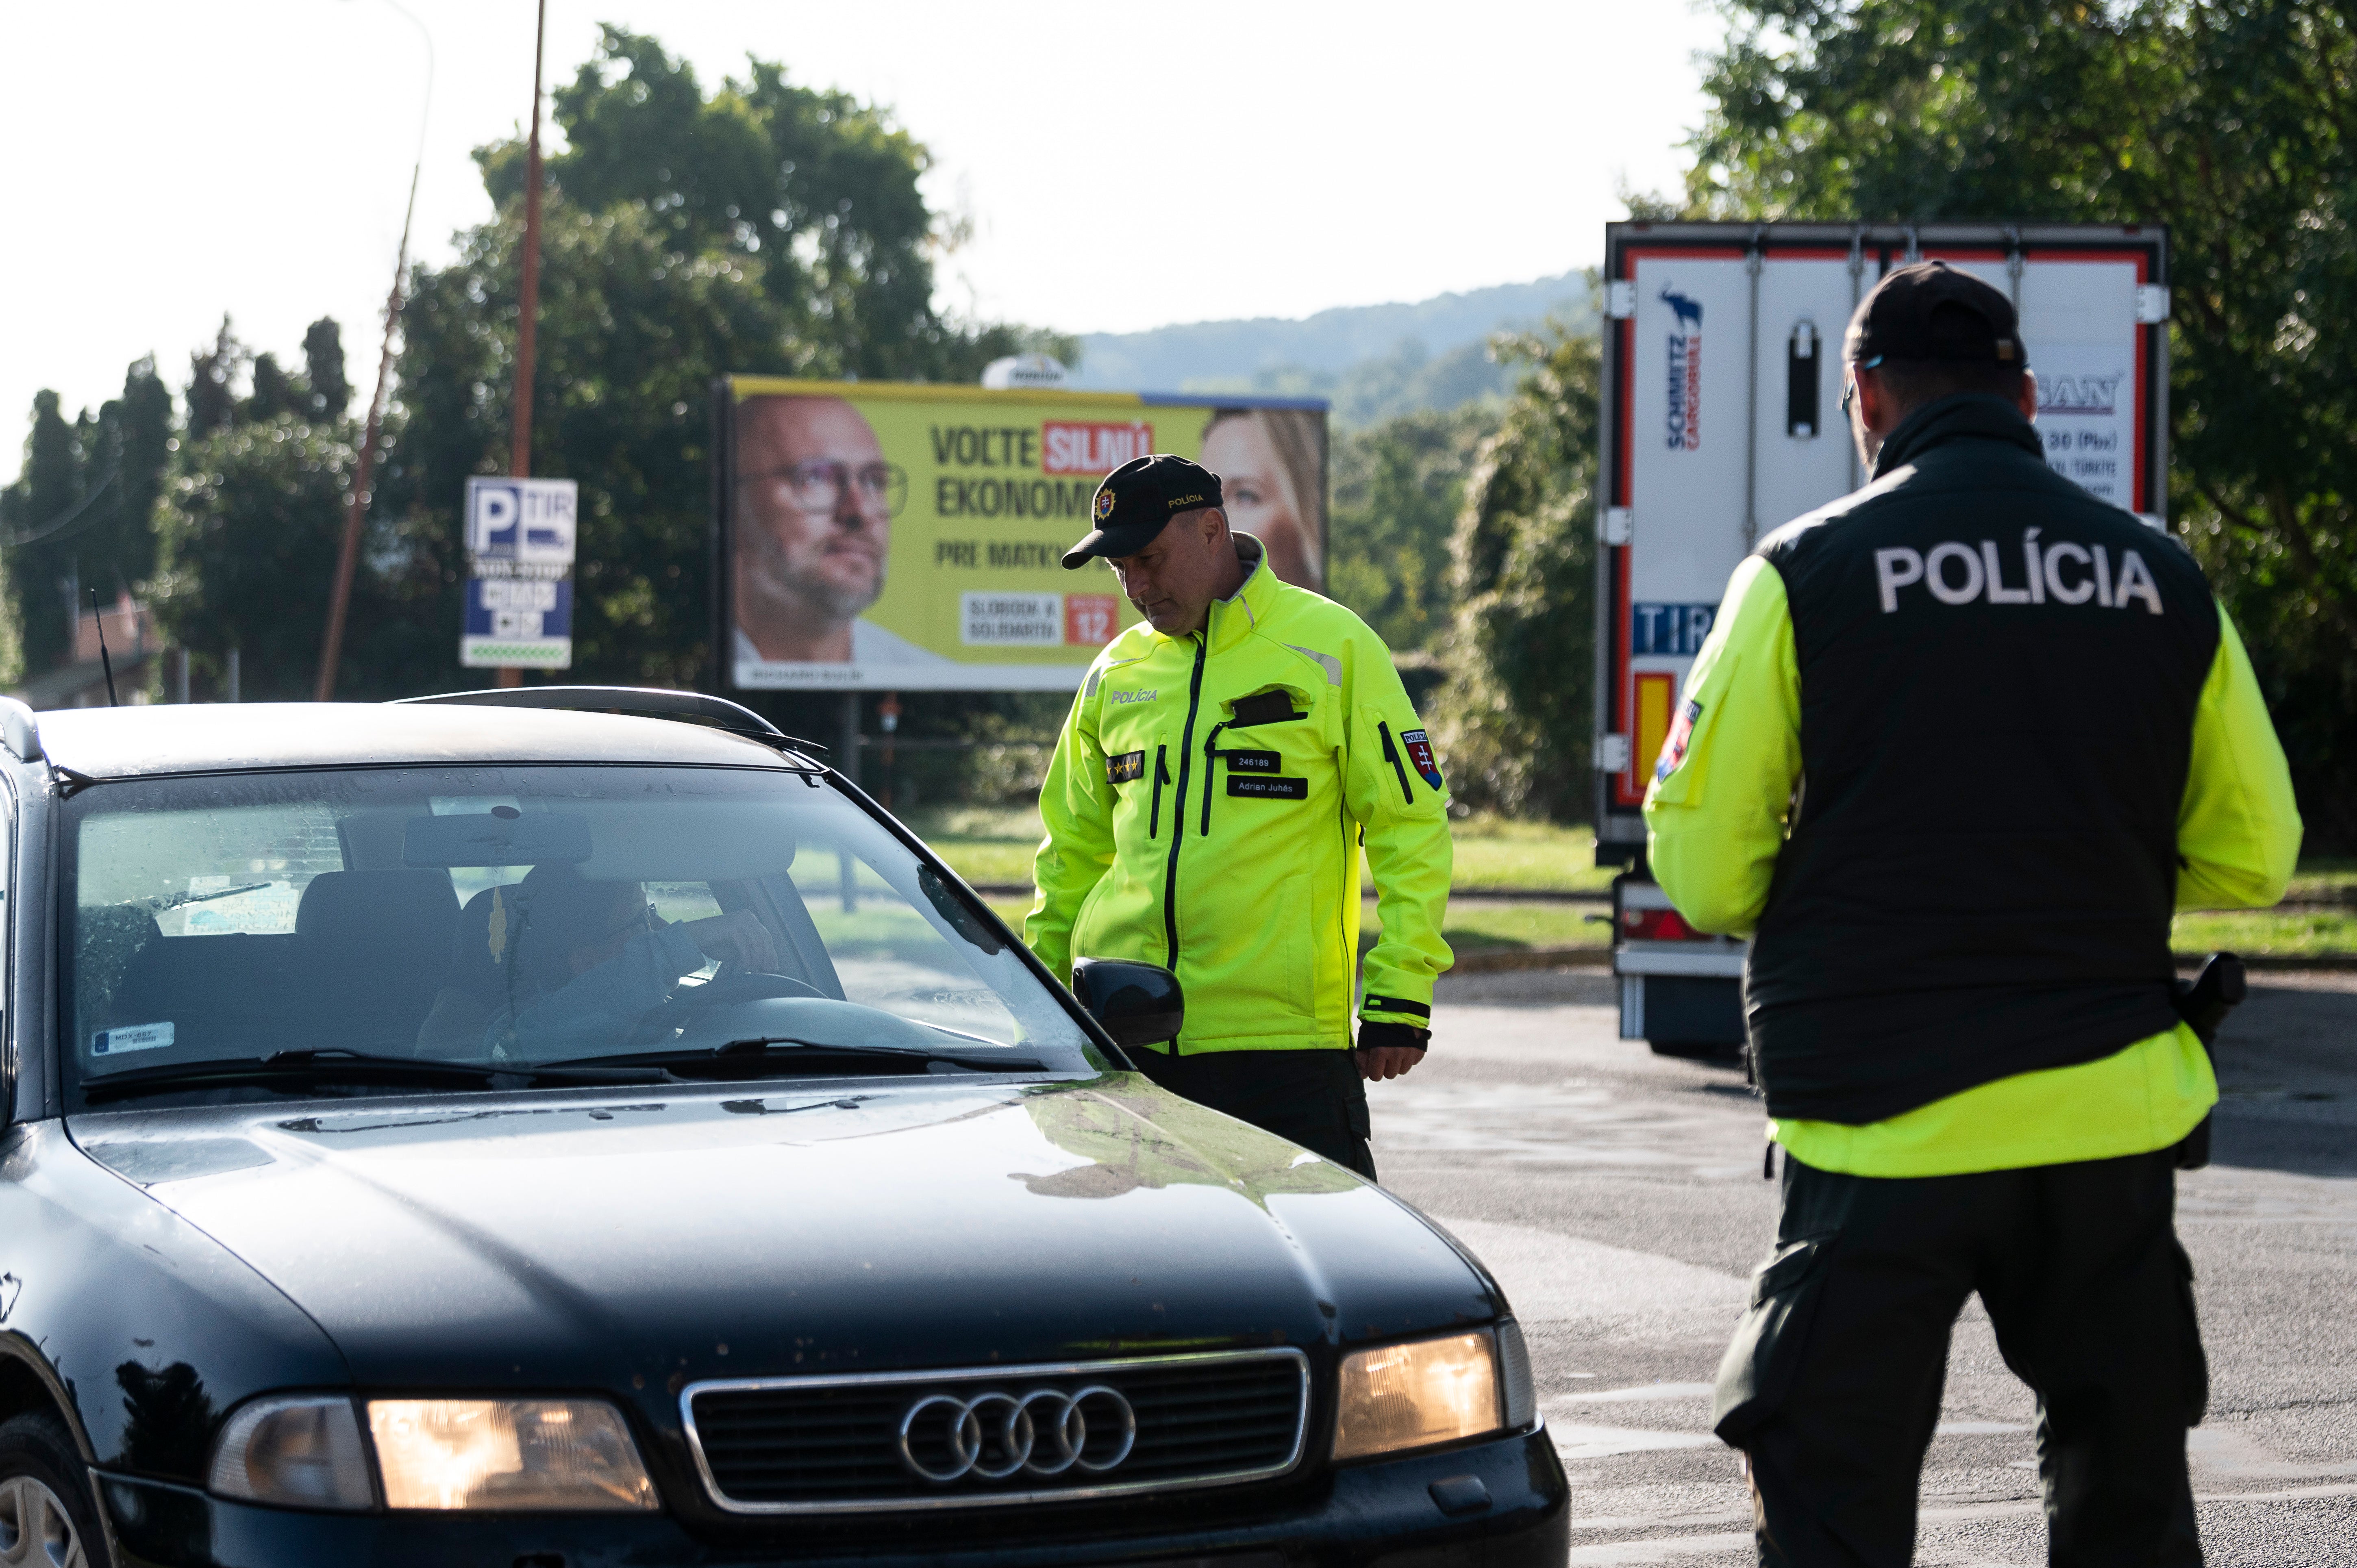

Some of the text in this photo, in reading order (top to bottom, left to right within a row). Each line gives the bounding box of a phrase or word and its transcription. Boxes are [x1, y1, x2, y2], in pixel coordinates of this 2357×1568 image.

[1669, 334, 1687, 450] SCHMITZ
[1168, 494, 1204, 508] POLÍCIA
[1875, 526, 2164, 615] POLÍCIA
[1076, 610, 1110, 643] 12
[1637, 607, 1712, 653] TIR
[1111, 688, 1157, 704] POLÍCIA
[1239, 758, 1269, 767] 246189
[1239, 782, 1293, 793] Adrian Juhás
